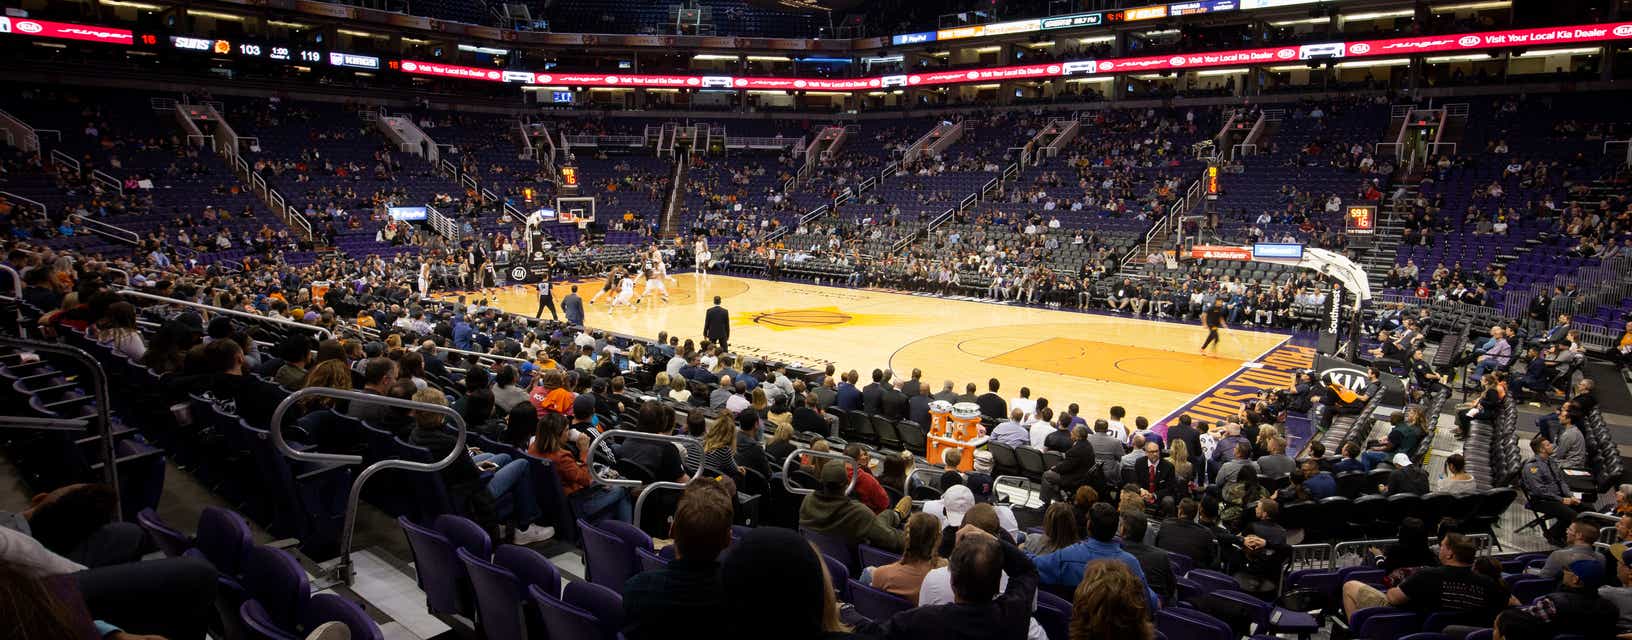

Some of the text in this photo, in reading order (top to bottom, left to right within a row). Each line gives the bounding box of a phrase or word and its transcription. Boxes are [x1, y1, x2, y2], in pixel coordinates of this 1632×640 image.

[1485, 35, 1506, 44] Visit
[1508, 34, 1528, 43] Your
[1530, 30, 1554, 41] Local
[1557, 30, 1573, 39] Kia
[1574, 28, 1607, 38] Dealer
[240, 44, 260, 56] 103
[301, 51, 320, 62] 119
[1220, 54, 1238, 62] Local
[1358, 217, 1368, 227] 16
[1328, 289, 1341, 334] Southwest
[1330, 372, 1366, 392] KIA
